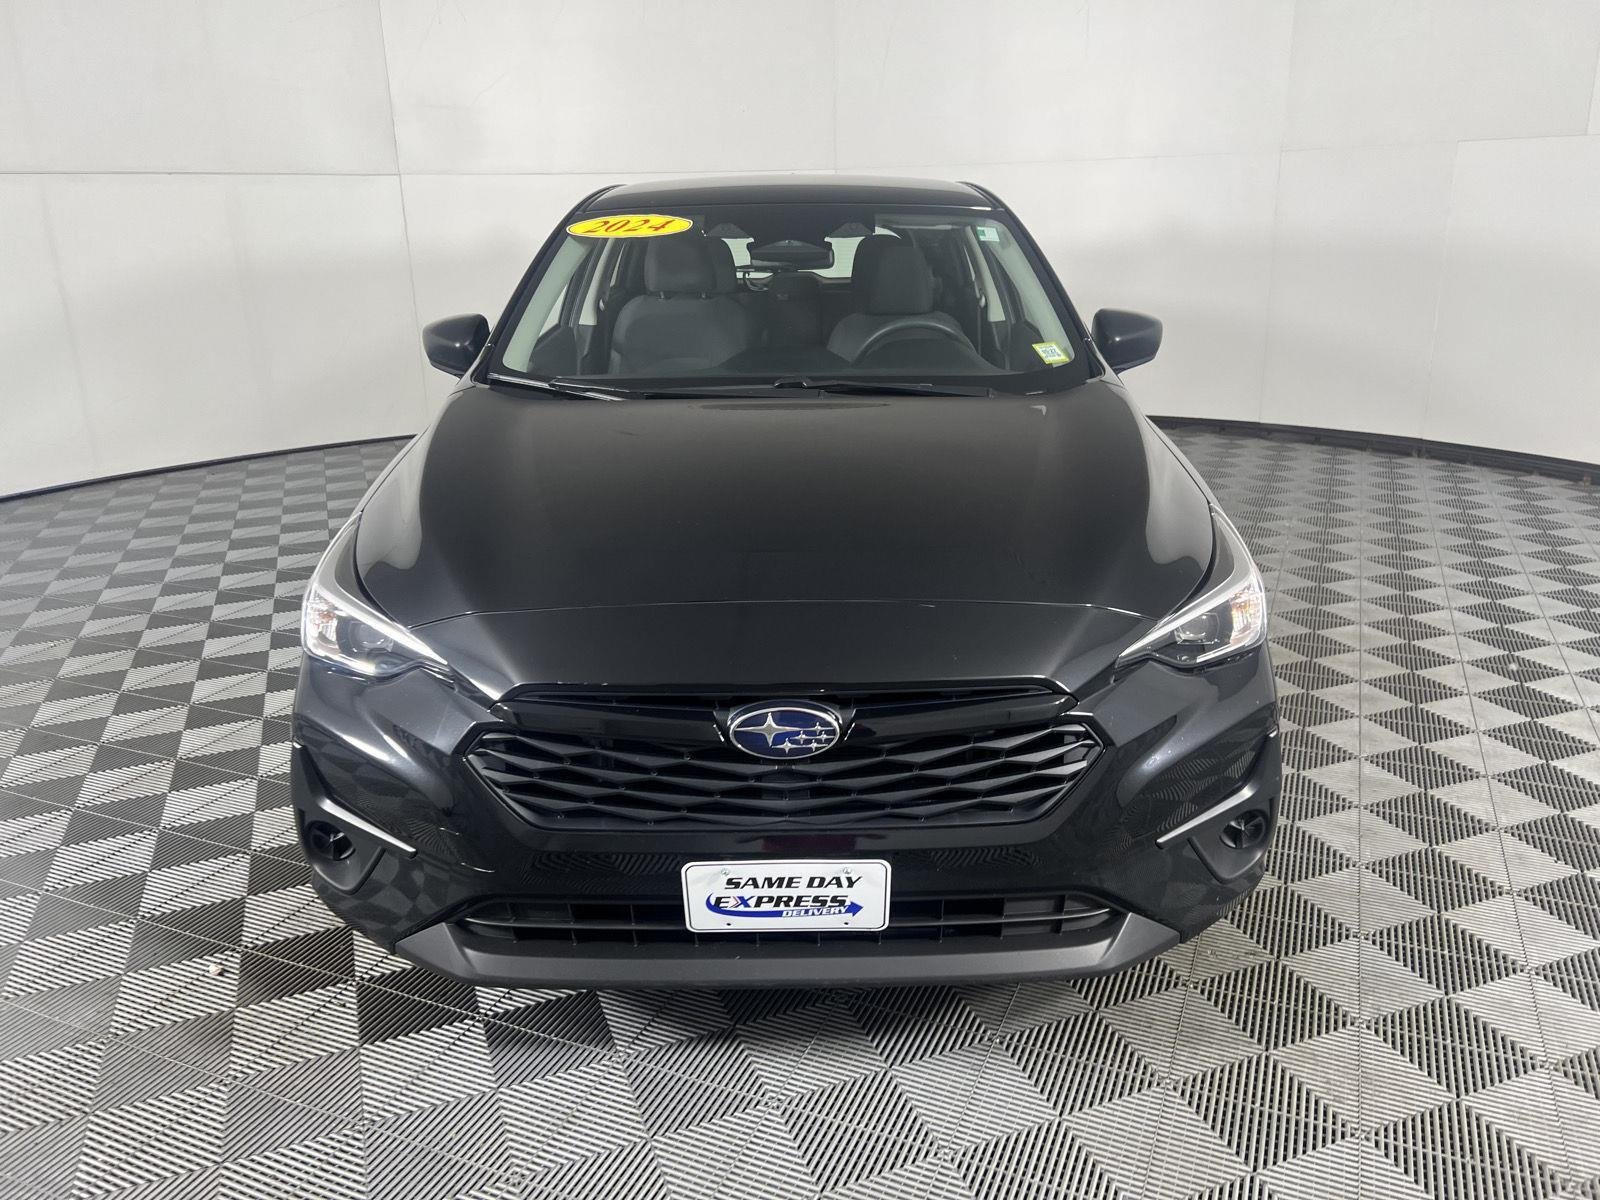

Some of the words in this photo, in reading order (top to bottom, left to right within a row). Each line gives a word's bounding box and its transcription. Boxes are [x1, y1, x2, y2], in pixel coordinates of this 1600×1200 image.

[582, 219, 676, 233] 2024
[724, 876, 802, 889] SAME
[806, 875, 863, 889] DAY
[713, 895, 848, 908] EXPRESS
[782, 906, 848, 918] DELIVERY
